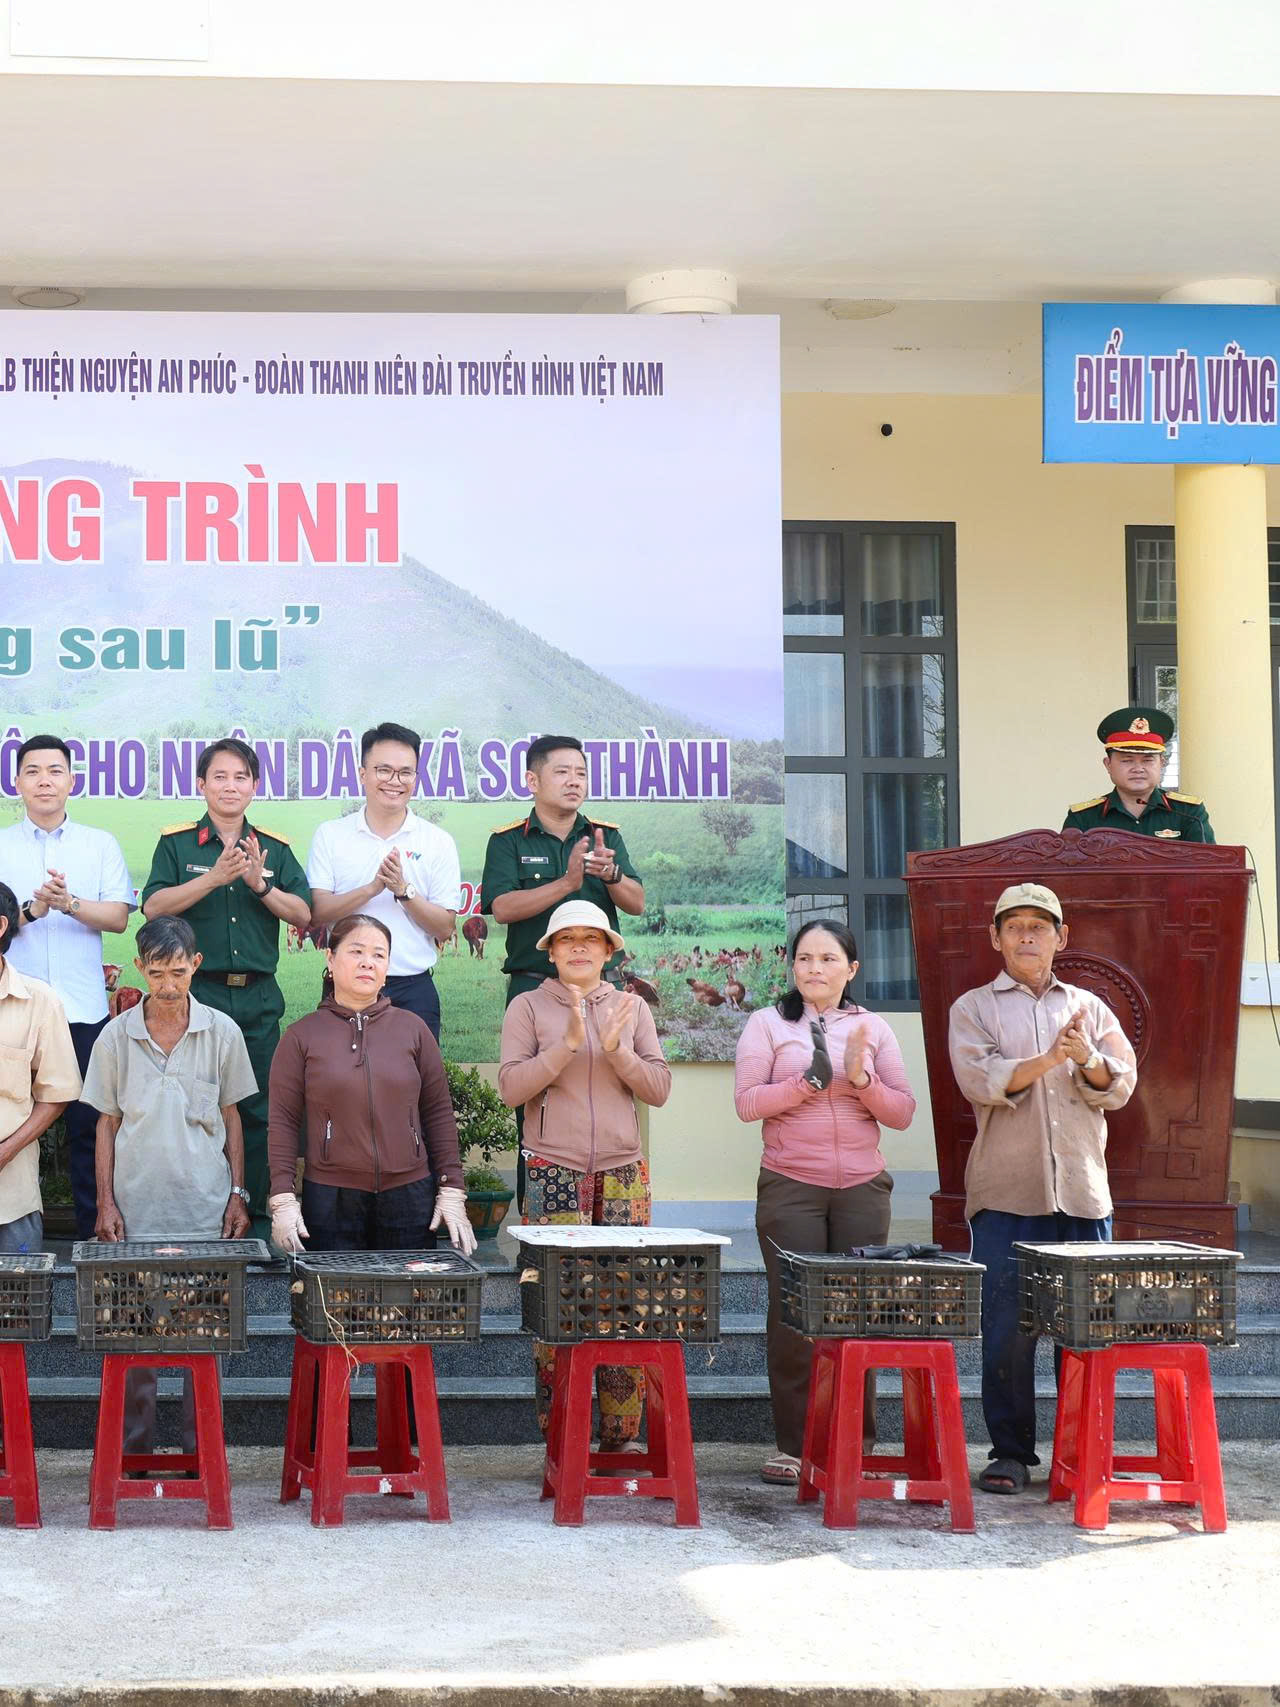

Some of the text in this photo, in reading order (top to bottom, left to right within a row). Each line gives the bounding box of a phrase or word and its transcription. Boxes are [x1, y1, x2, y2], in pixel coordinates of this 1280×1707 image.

[22, 350, 74, 402] THIỆN
[80, 351, 152, 402] NGUYỆN
[157, 359, 183, 393] AN
[189, 352, 237, 395] PHÚC
[254, 352, 304, 395] ĐOÀN
[309, 360, 368, 396] THANH
[374, 353, 417, 396] NIÊN
[422, 353, 452, 396] ĐÀI
[457, 351, 526, 397] TRUYỀN
[531, 354, 574, 397] HÌNH
[579, 354, 617, 405] VIỆT
[622, 362, 664, 397] NAM
[1075, 328, 1277, 438] ĐIỂM TỰA VỮNG
[132, 463, 400, 563] TRÌNH
[58, 626, 186, 671] sau
[583, 730, 729, 798] THÀNH
[405, 850, 422, 861] VTV
